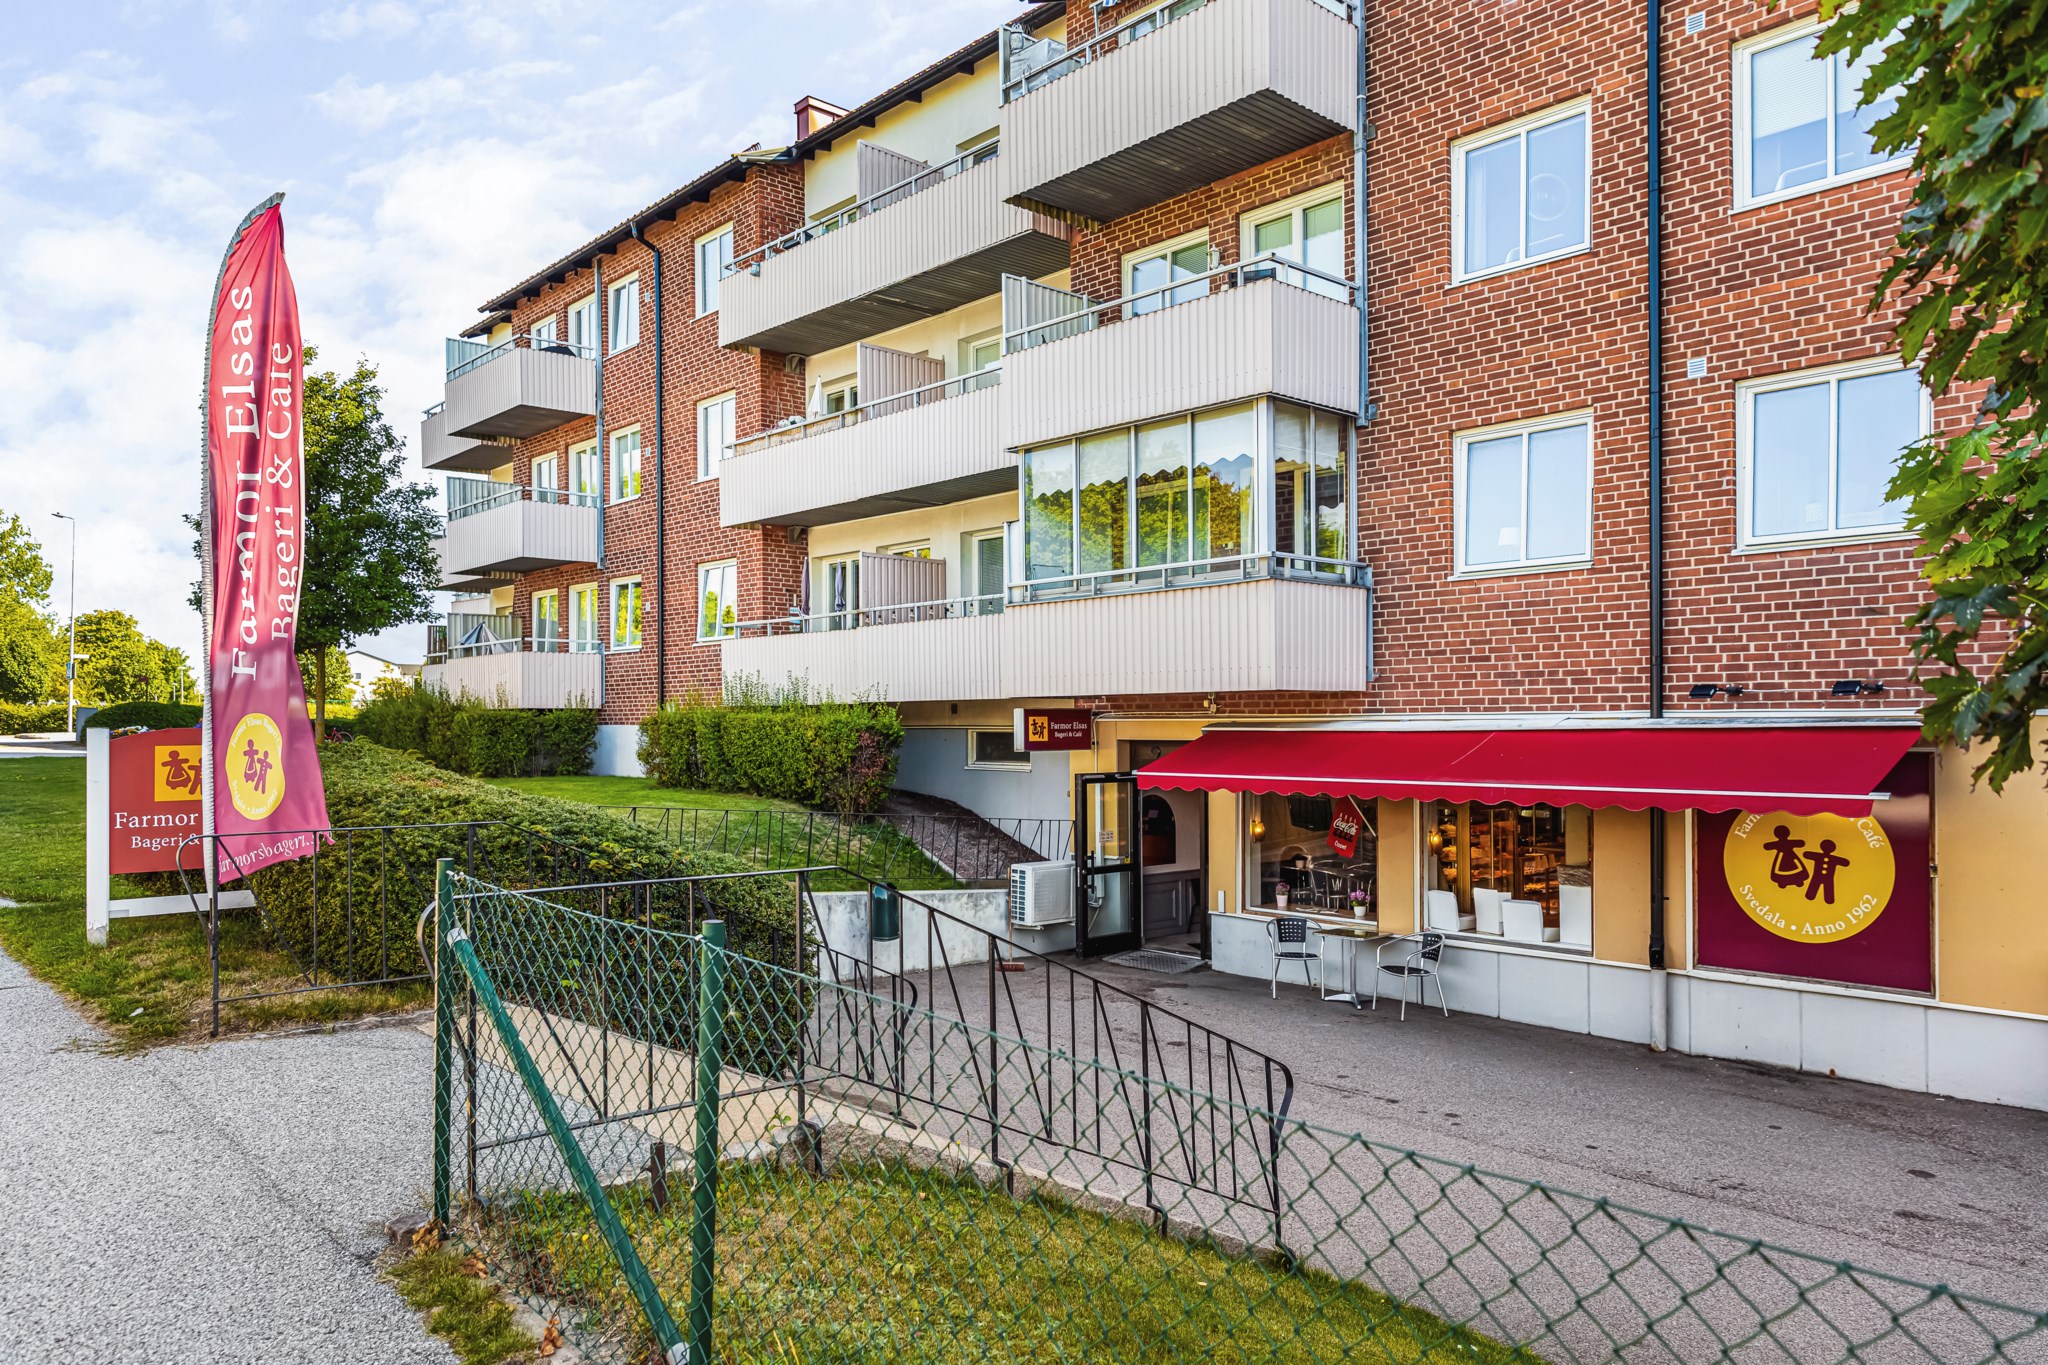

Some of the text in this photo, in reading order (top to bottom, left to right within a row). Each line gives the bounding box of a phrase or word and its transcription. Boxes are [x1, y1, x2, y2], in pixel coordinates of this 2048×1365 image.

[222, 285, 262, 681] Farmor Elsas
[266, 453, 293, 489] &
[265, 504, 298, 641] Bageri
[1054, 731, 1069, 739] Bageri
[114, 812, 199, 829] Farmor
[1857, 818, 1885, 849] Café
[131, 833, 183, 851] Bageri
[1739, 884, 1878, 935] Svedala Anno 1962
